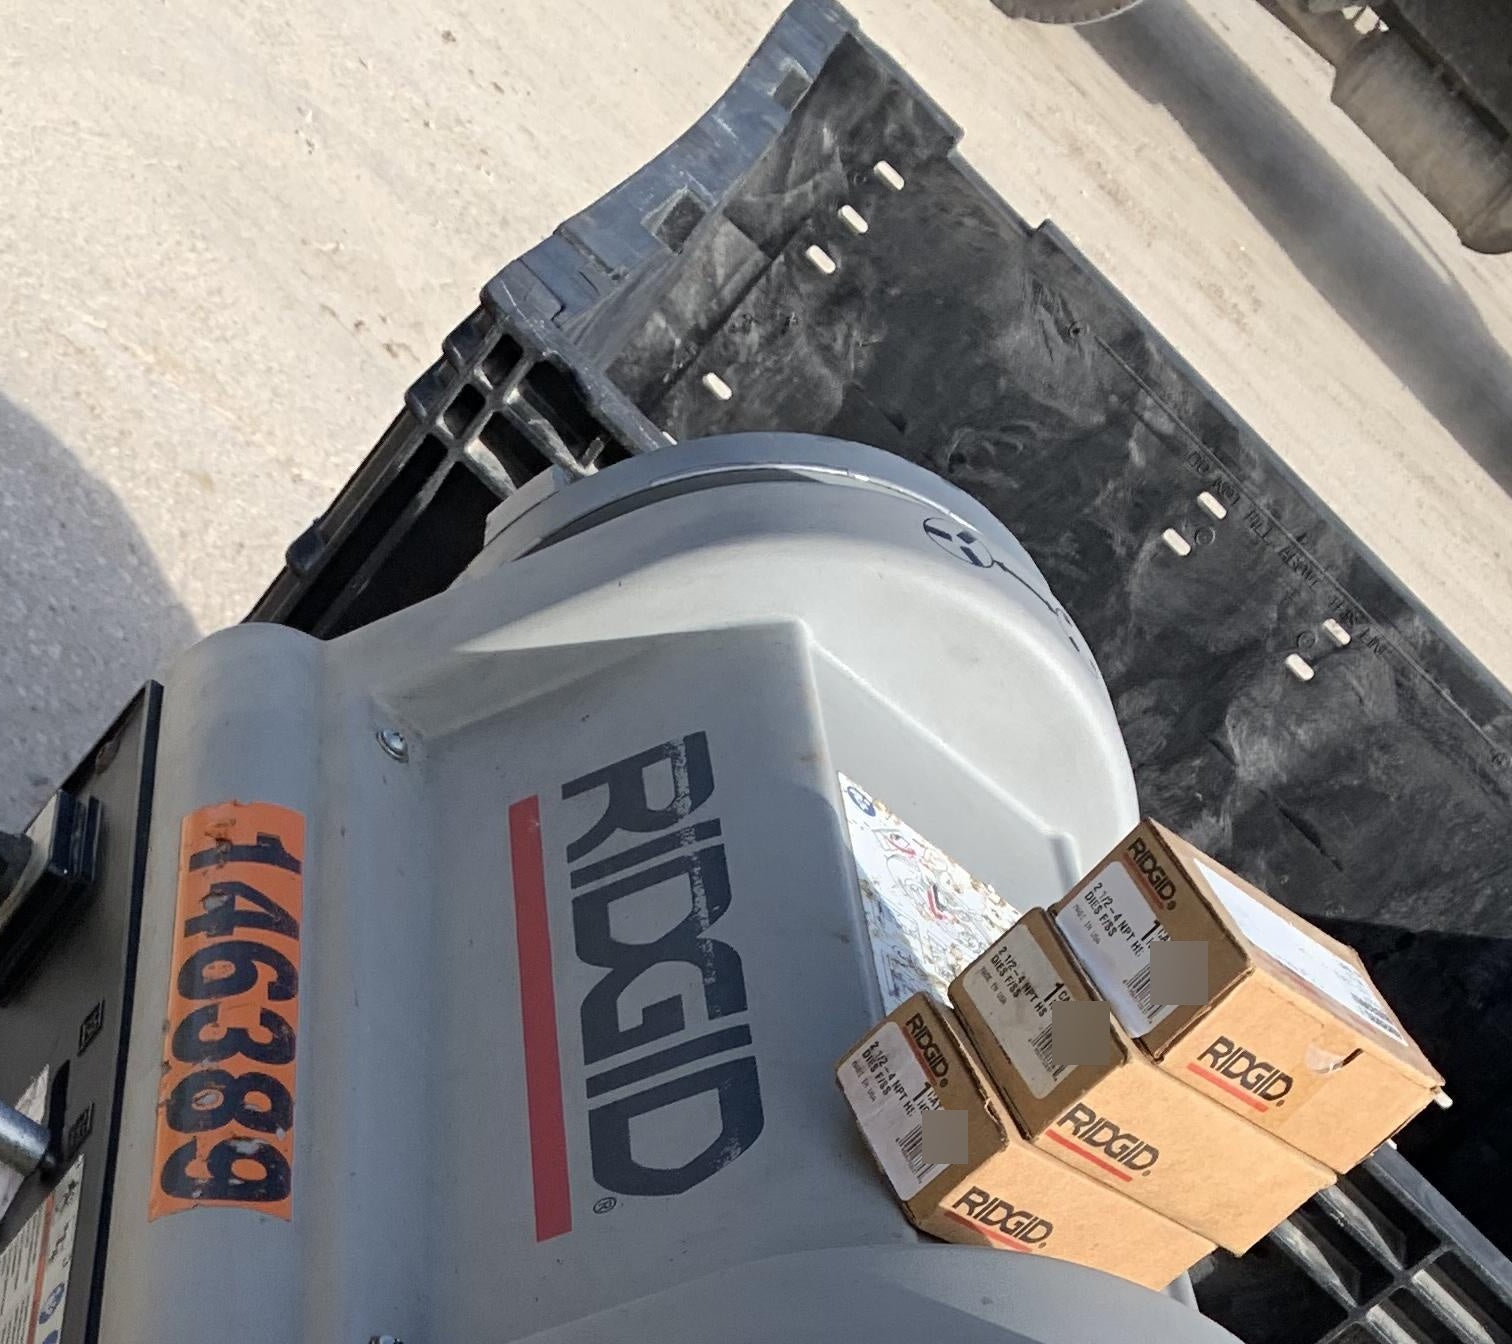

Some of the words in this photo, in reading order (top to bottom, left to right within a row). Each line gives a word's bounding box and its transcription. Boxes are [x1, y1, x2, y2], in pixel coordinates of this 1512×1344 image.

[1126, 836, 1178, 903] RIDGID
[1084, 891, 1102, 915] DIES
[1092, 882, 1102, 892] 2
[1117, 920, 1134, 942] NPT
[562, 731, 765, 1197] RIDGID
[990, 954, 1007, 977] DIES
[997, 945, 1007, 956] 2
[1021, 981, 1037, 1003] NPT
[1034, 1001, 1046, 1017] HS
[1042, 979, 1065, 1003] 1
[160, 830, 302, 1203] 146389
[904, 1012, 950, 1080] RIDGID
[861, 1048, 878, 1073] DIES
[869, 1039, 880, 1052] 2
[891, 1079, 907, 1102] NPT
[1198, 1036, 1293, 1102] RIDGID
[1058, 1103, 1160, 1172] RIDGID
[952, 1186, 1053, 1244] RIDGID
